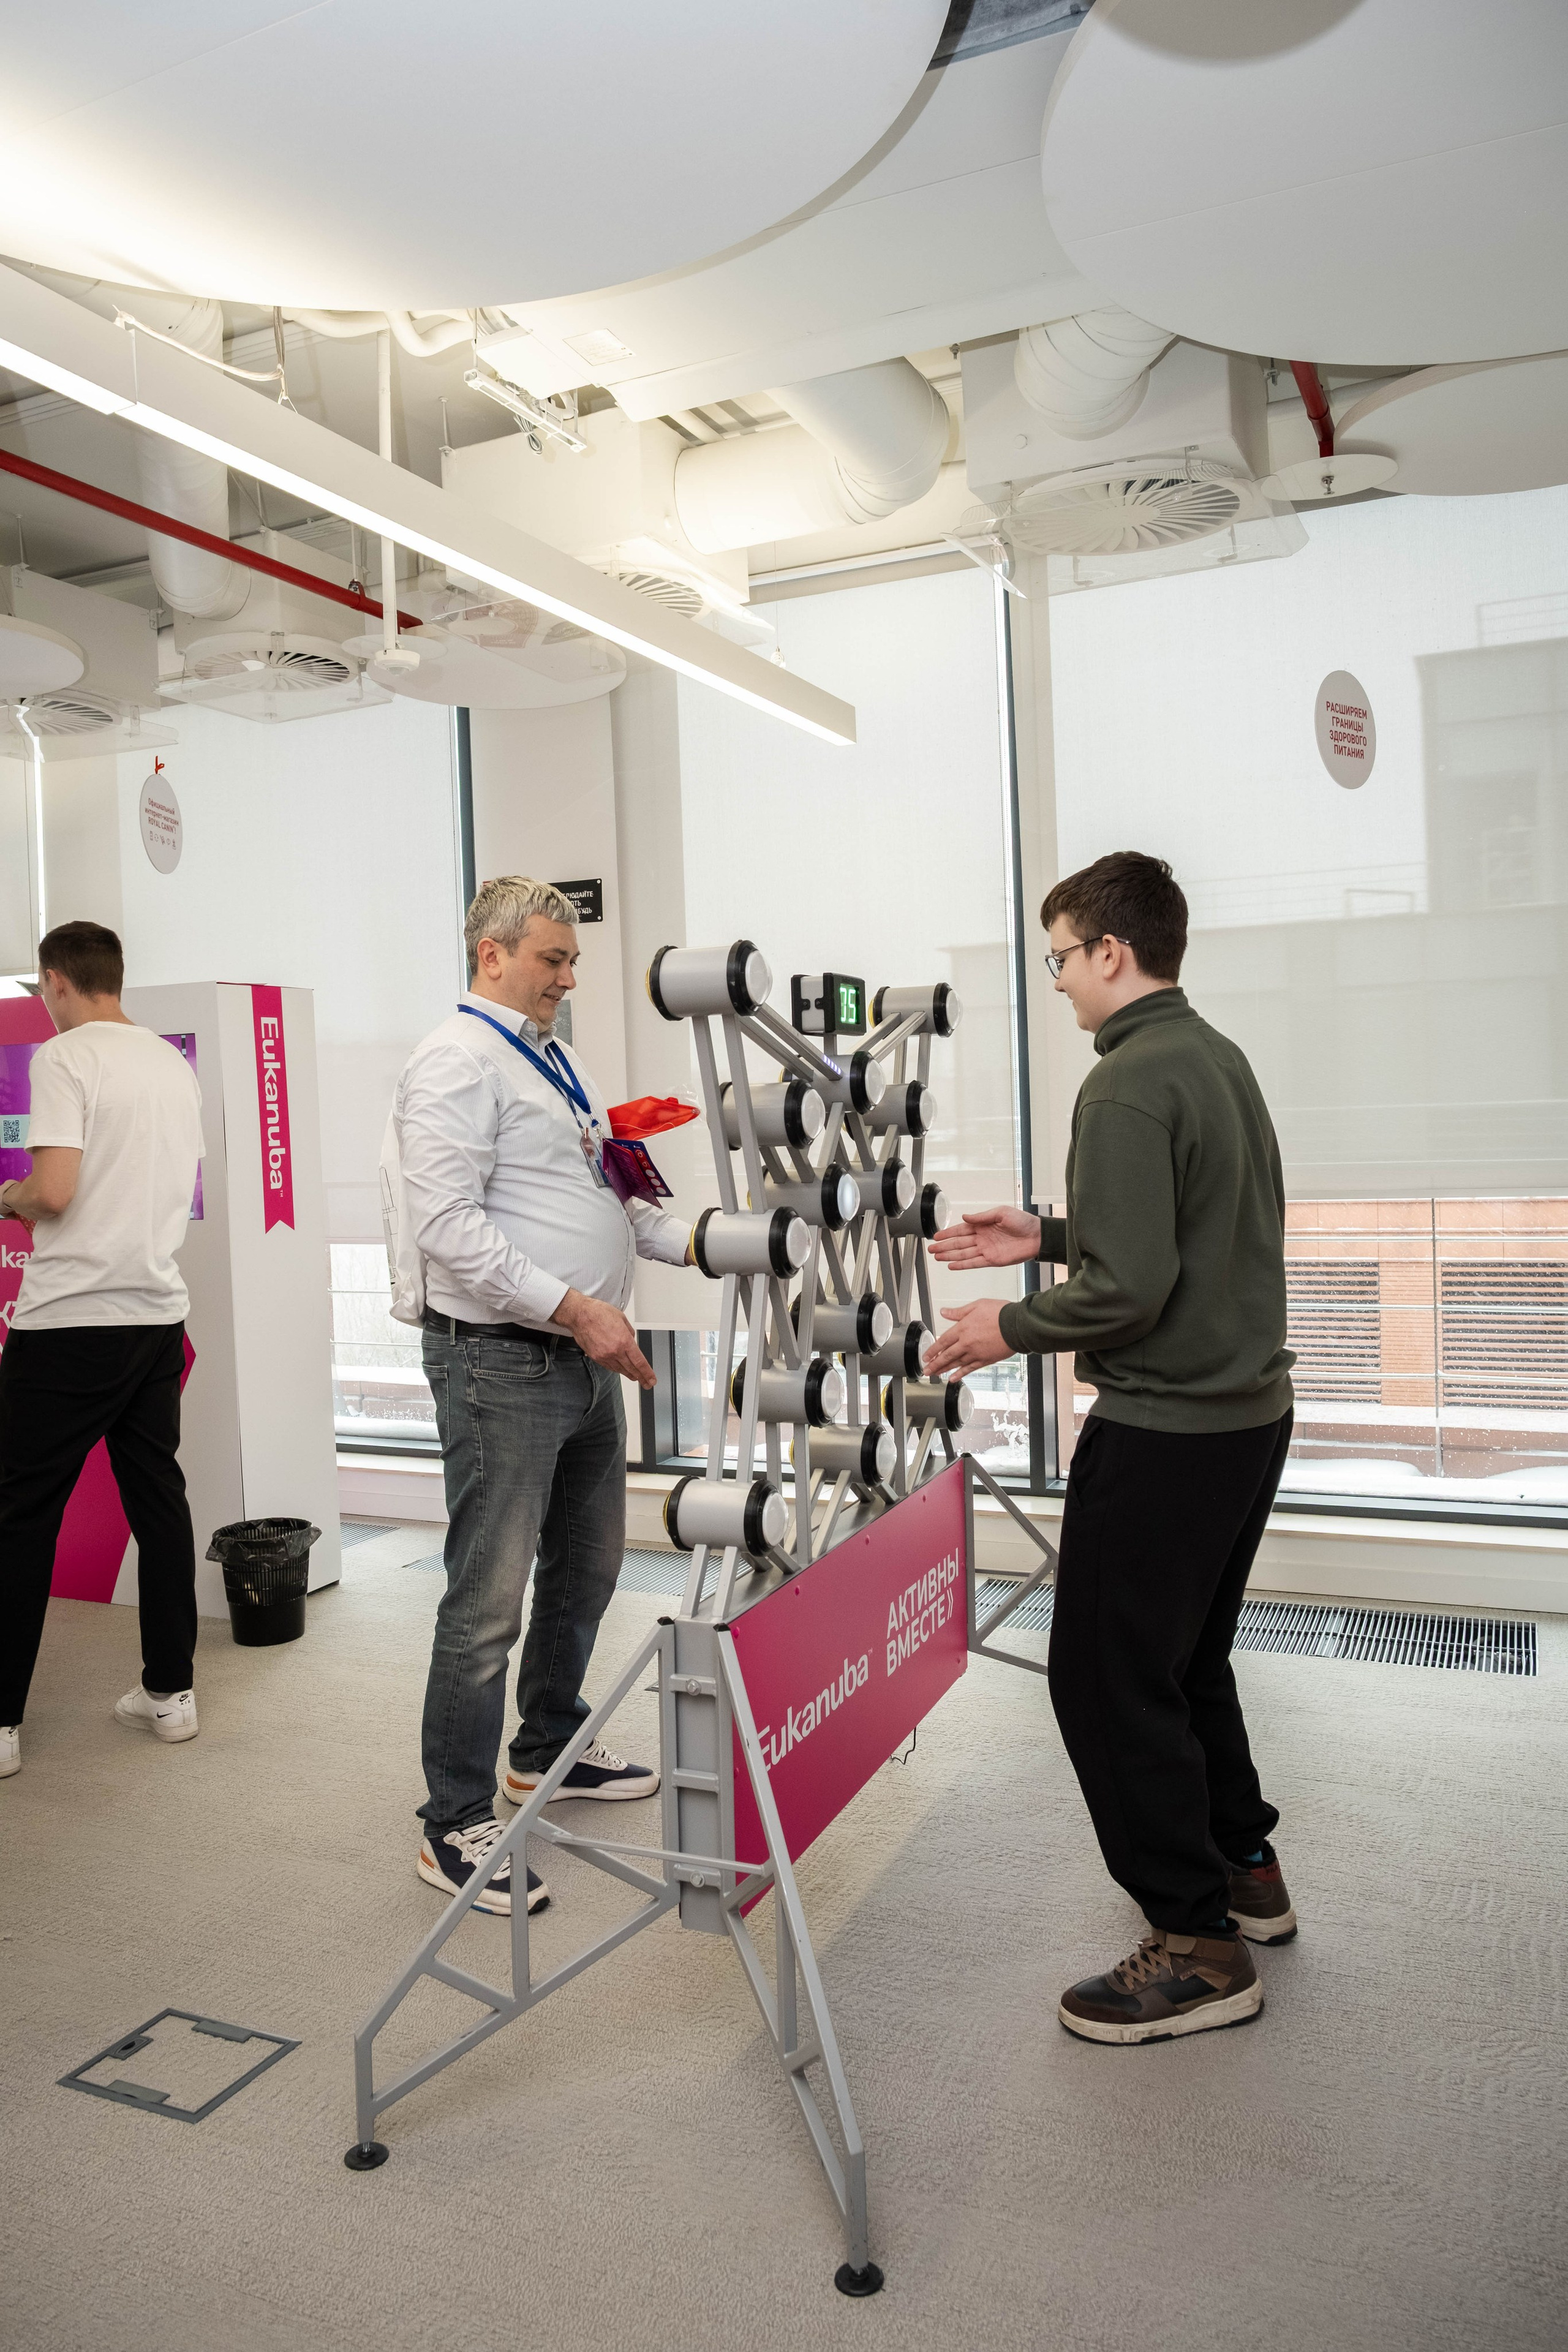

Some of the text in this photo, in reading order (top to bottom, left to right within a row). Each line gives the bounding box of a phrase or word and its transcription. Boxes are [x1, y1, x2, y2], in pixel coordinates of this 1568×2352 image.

[1326, 701, 1367, 720] РАСШИРЯЕМ
[1332, 716, 1363, 733] ГРАНИЦЫ
[1329, 729, 1367, 747] ЗДОРОВОГО
[1333, 744, 1365, 760] ПИТАНИЯ
[148, 797, 175, 816] Официальный
[145, 807, 179, 826] интернет-магазин
[148, 816, 160, 829] ROYAL
[563, 891, 594, 899] ЛЮДАЙТЕ
[887, 1547, 959, 1640] АКТИВНЫ
